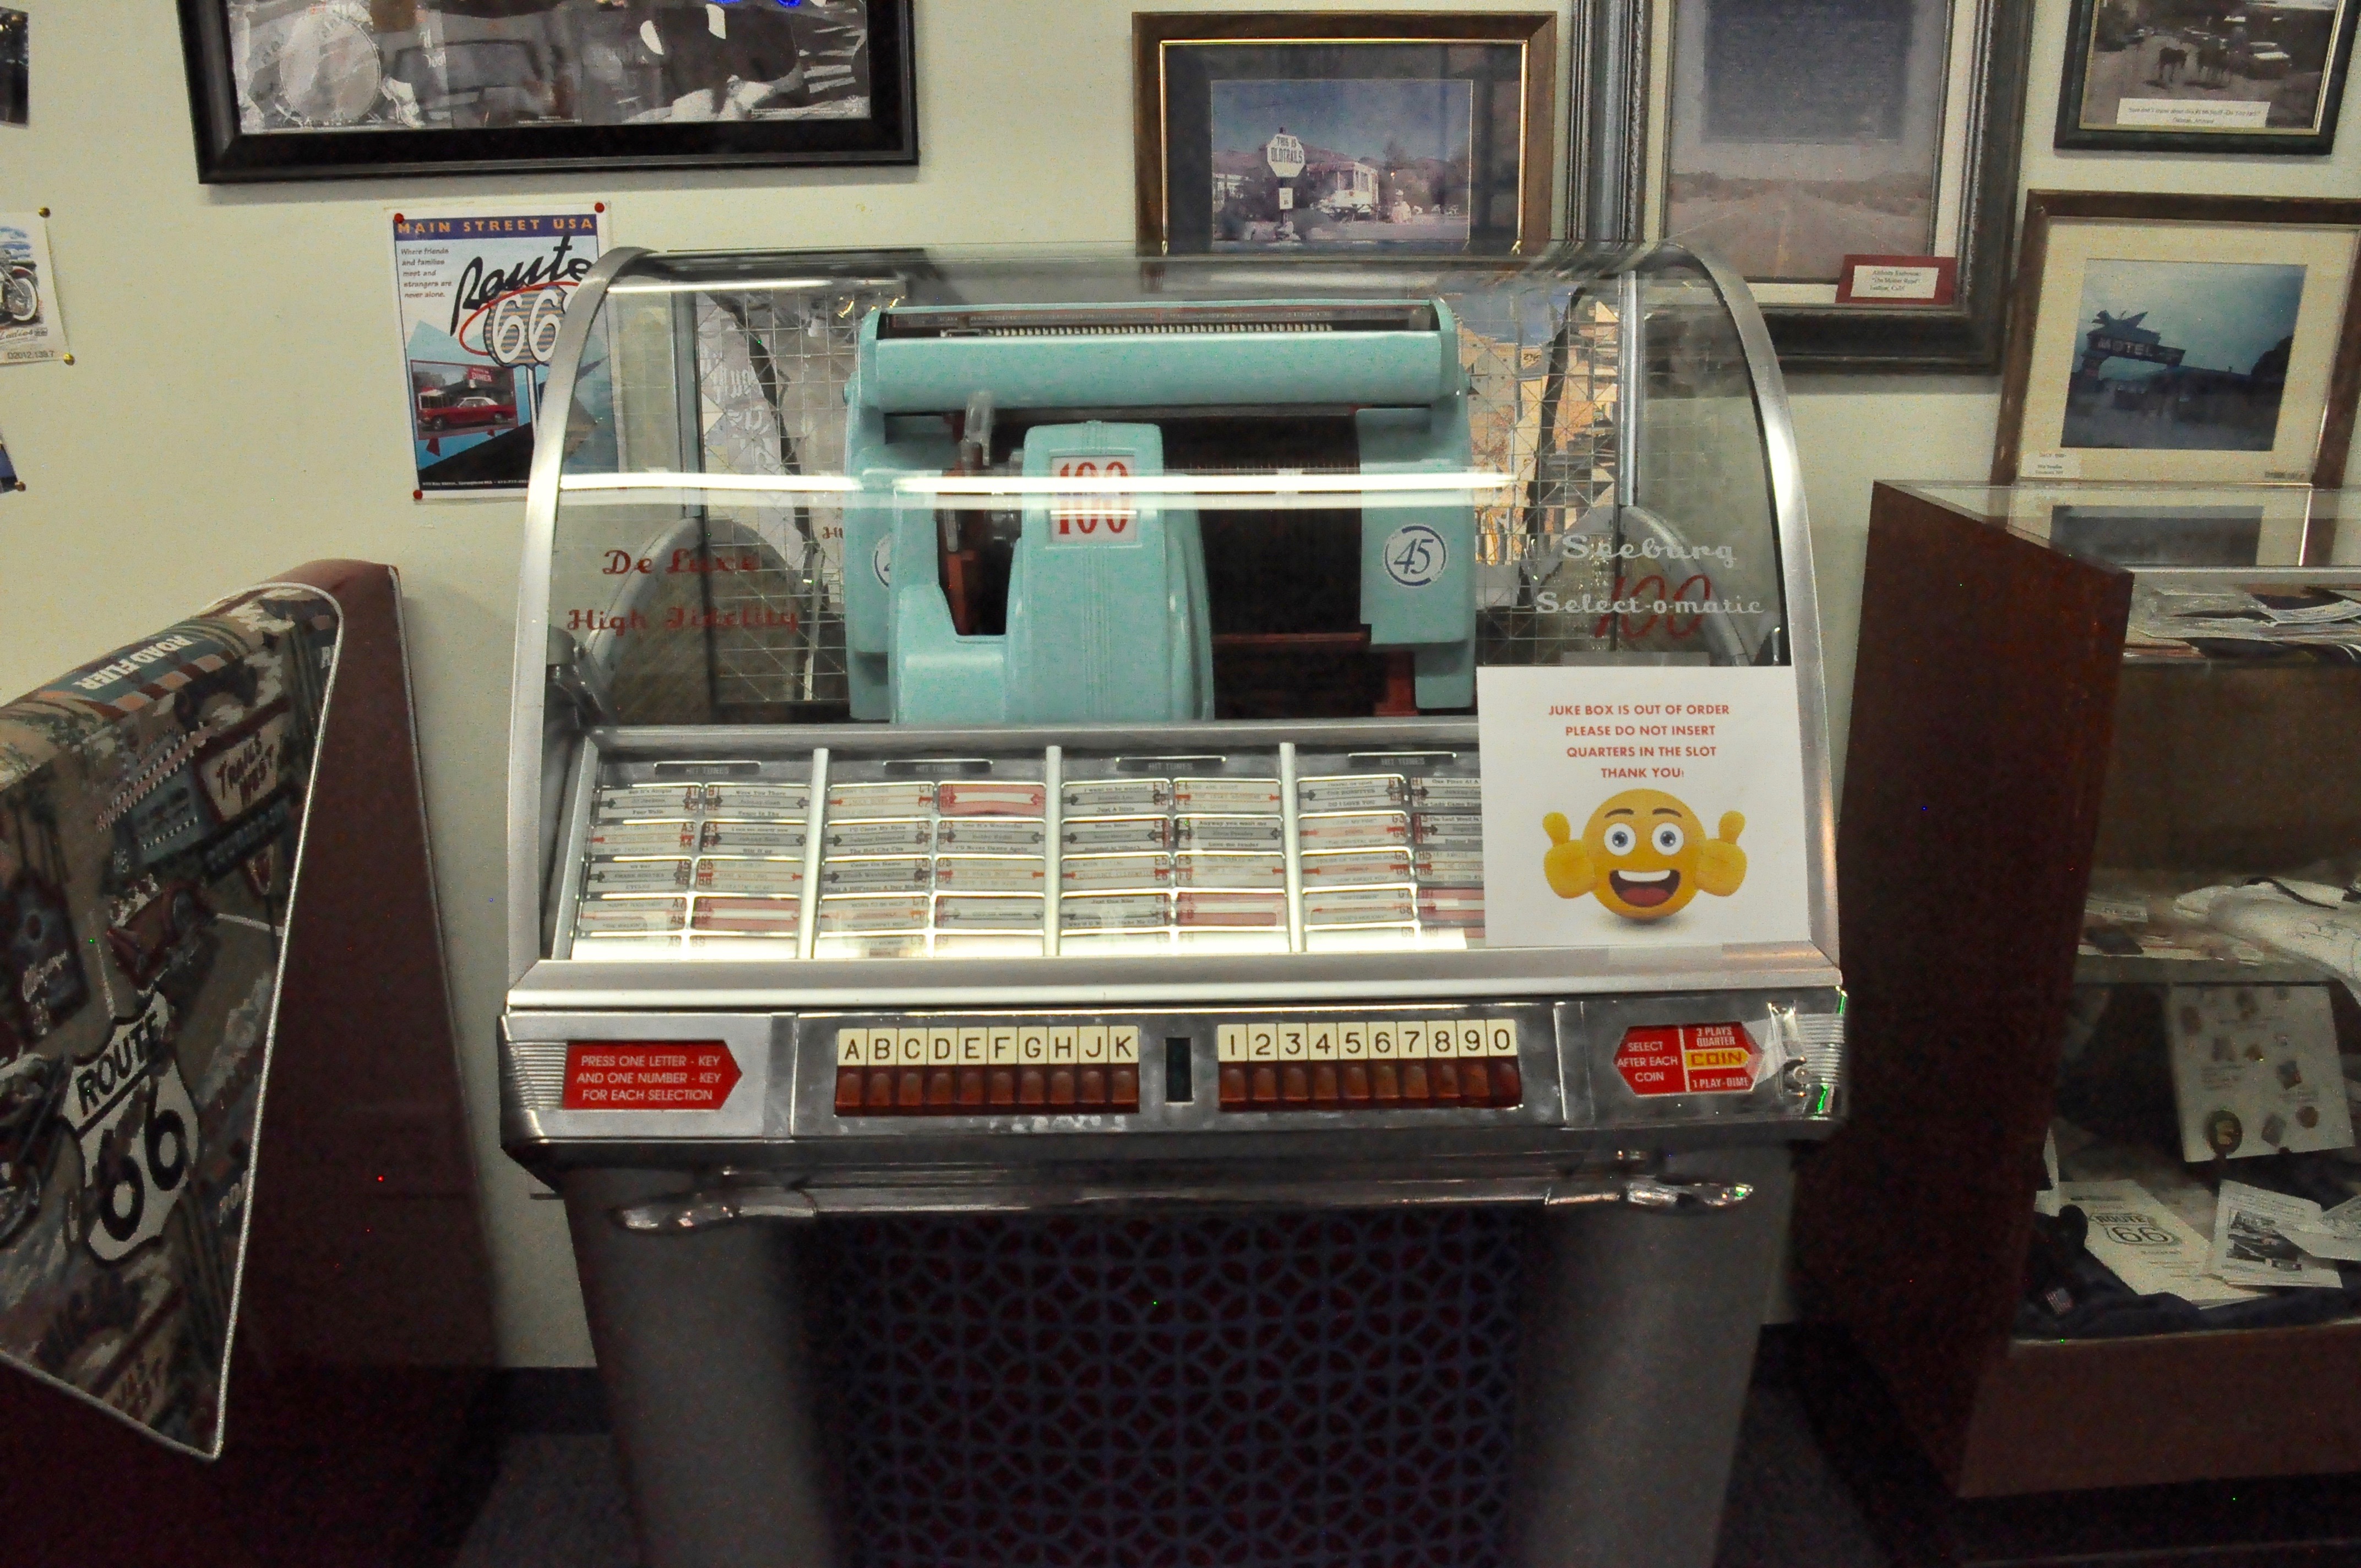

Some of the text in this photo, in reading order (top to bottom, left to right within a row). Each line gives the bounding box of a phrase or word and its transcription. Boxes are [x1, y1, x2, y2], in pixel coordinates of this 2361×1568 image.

[398, 218, 593, 233] MAIN STREET USA
[450, 231, 594, 337] Route
[492, 288, 562, 364] 66
[1059, 461, 1129, 535] 100
[1393, 538, 1434, 575] 45
[1562, 535, 1737, 569] Seeburg
[602, 550, 655, 575] De
[1593, 574, 1712, 640] 100
[567, 608, 648, 636] High
[130, 635, 194, 663] ROAD
[1548, 704, 1730, 716] JUKE BOX IS OUT OF ORDER
[1565, 725, 1716, 737] PLEASE DO NOT INSERT
[1566, 747, 1717, 759] QUARTERS IN THE SLOT
[1601, 767, 1647, 778] THANK
[1696, 1027, 1732, 1037] 3 PLAYS
[844, 1036, 1132, 1060] A B C D E F G H J K
[1230, 1029, 1510, 1055] 1 2 3 4 5 6 7 8 9 0
[1628, 1041, 1663, 1052] SELECT
[1696, 1036, 1736, 1047] QUARTER
[77, 1010, 164, 1118] ROUTE
[581, 1055, 615, 1066] PRESS
[619, 1055, 645, 1066] ONE
[649, 1055, 687, 1066] LETTER
[698, 1055, 721, 1066] KEY
[1618, 1056, 1678, 1068] AFTER EACH
[1690, 1052, 1742, 1066] COIN
[577, 1072, 604, 1084] AND
[607, 1072, 633, 1084] ONE
[638, 1072, 688, 1084] NUMBER
[699, 1072, 722, 1084] KEY
[1635, 1072, 1664, 1082] COIN
[1693, 1079, 1698, 1088] 1
[583, 1090, 713, 1101] FOR EACH SELECTION
[97, 1075, 188, 1242] 66
[2096, 1215, 2147, 1224] ROUTE
[2112, 1227, 2169, 1243] 66
